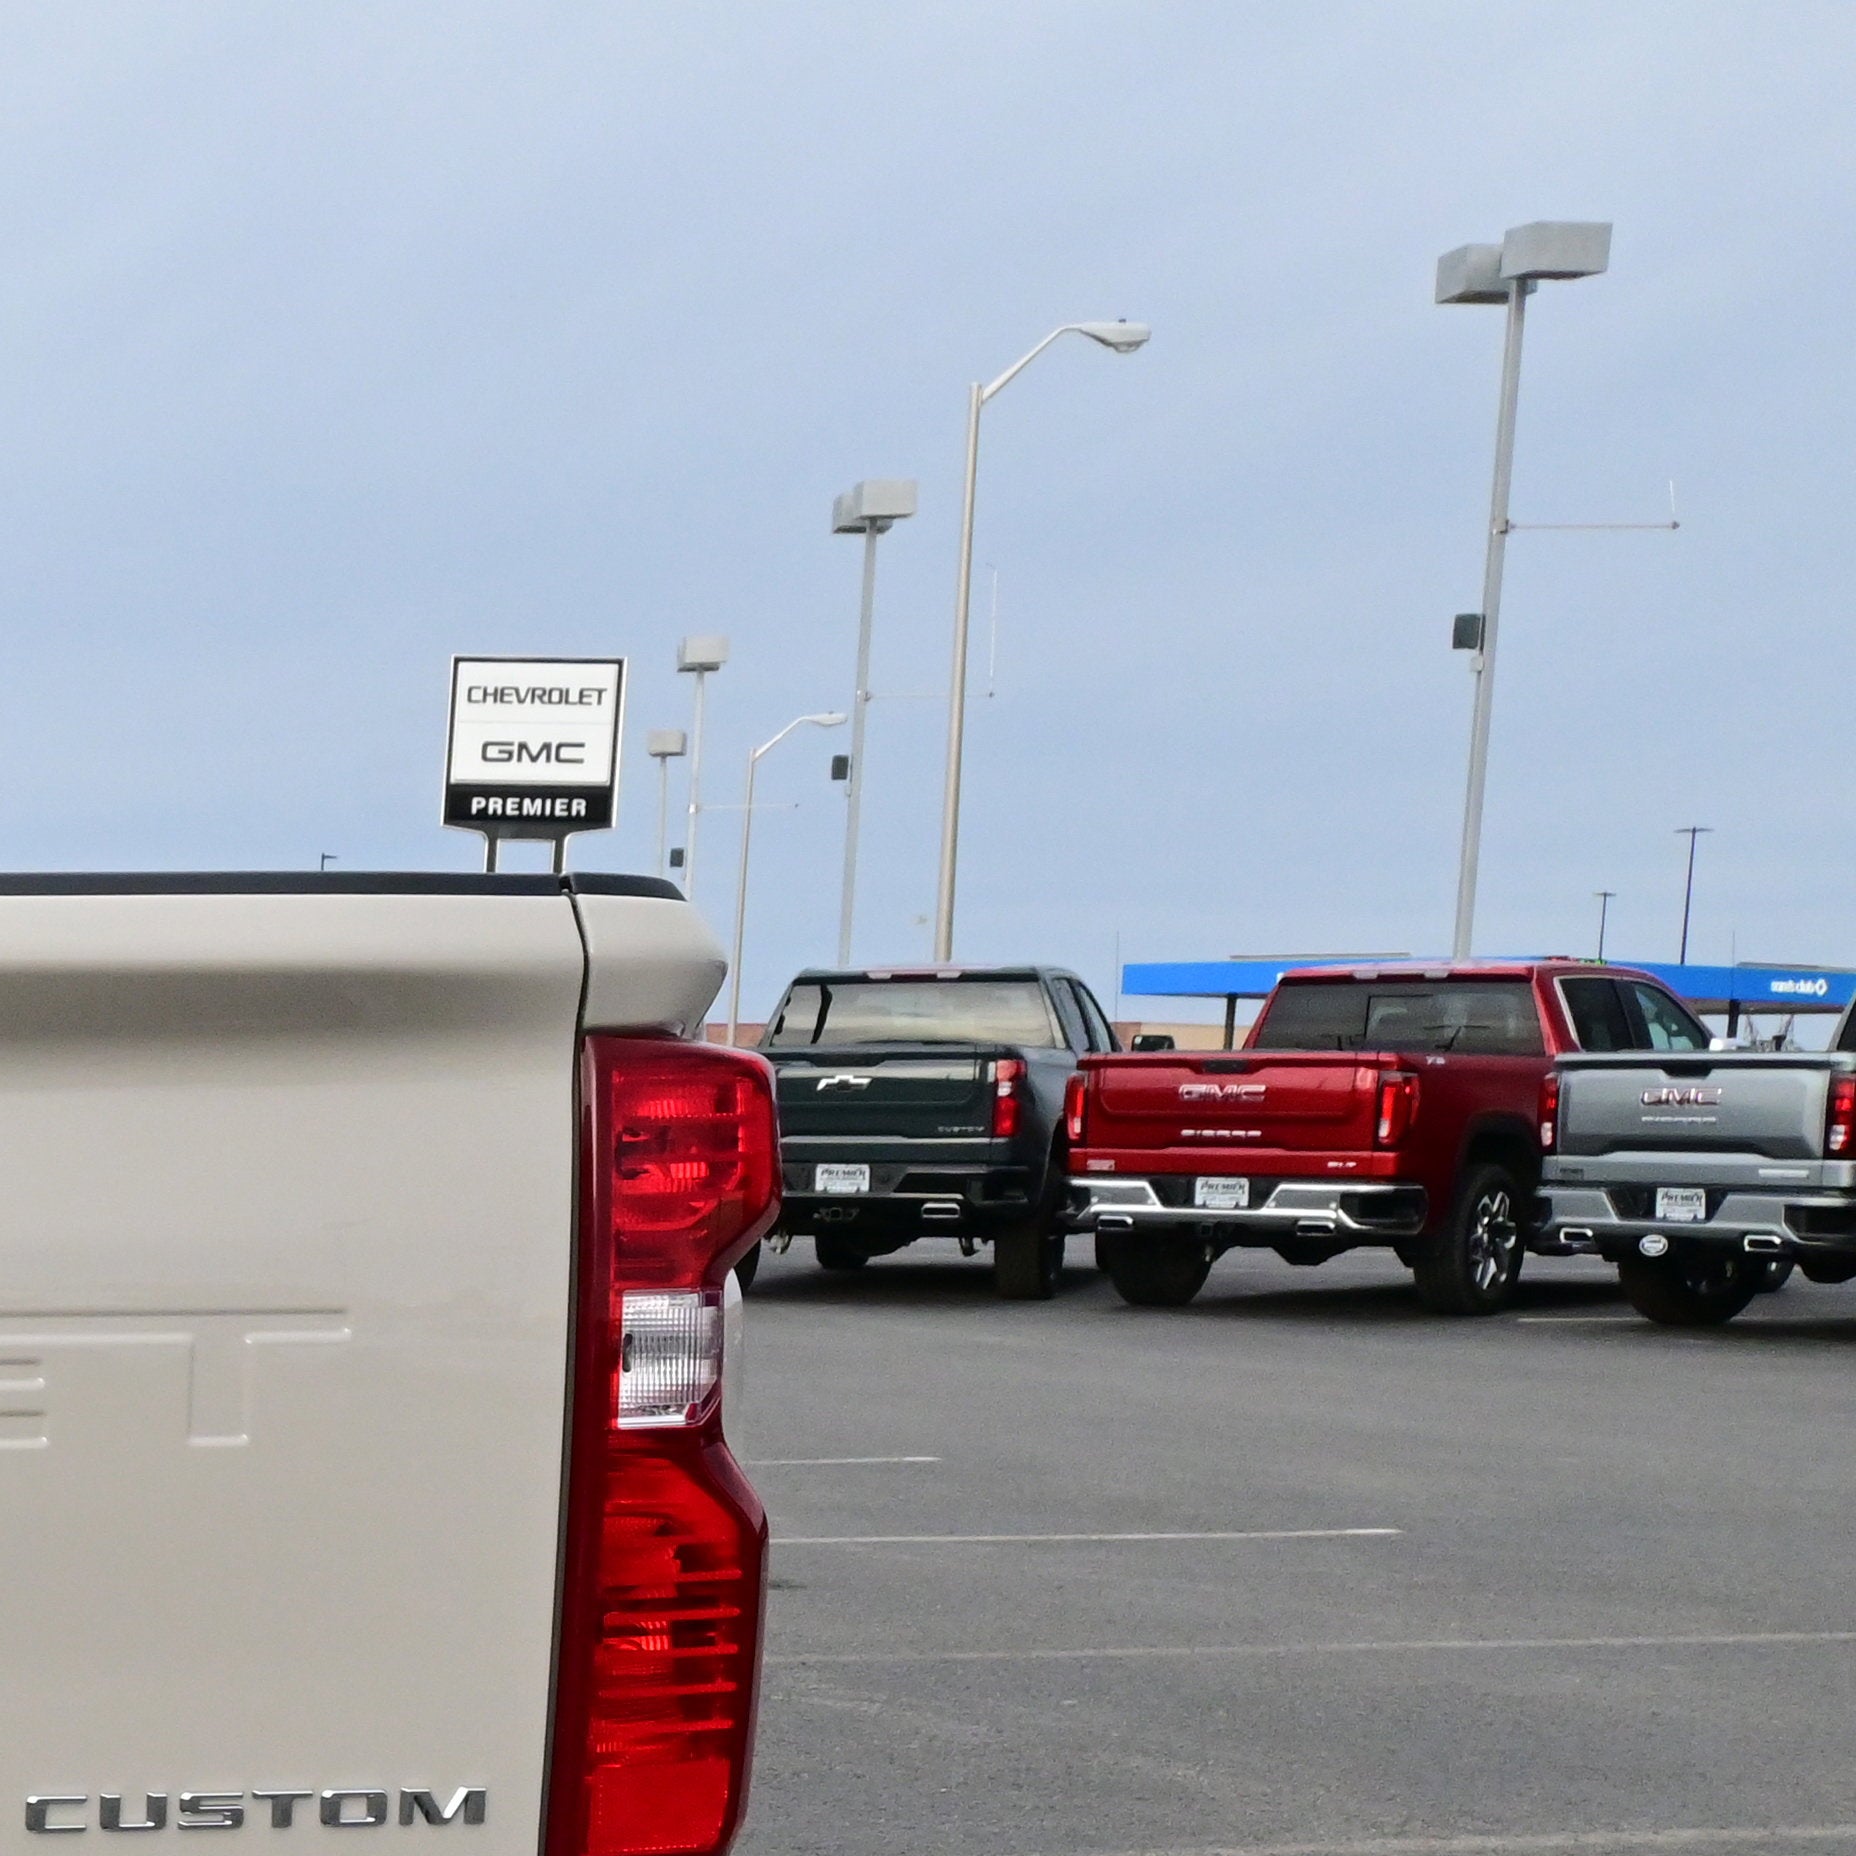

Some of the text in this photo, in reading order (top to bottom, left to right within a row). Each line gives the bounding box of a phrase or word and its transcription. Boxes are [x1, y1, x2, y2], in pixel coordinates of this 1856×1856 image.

[466, 685, 608, 706] CHEVROLET
[481, 741, 586, 764] GMC
[471, 796, 588, 817] PREMIER
[1178, 1084, 1267, 1101] GMC
[1640, 1088, 1722, 1105] GMC
[24, 1785, 488, 1834] CUSTOM
